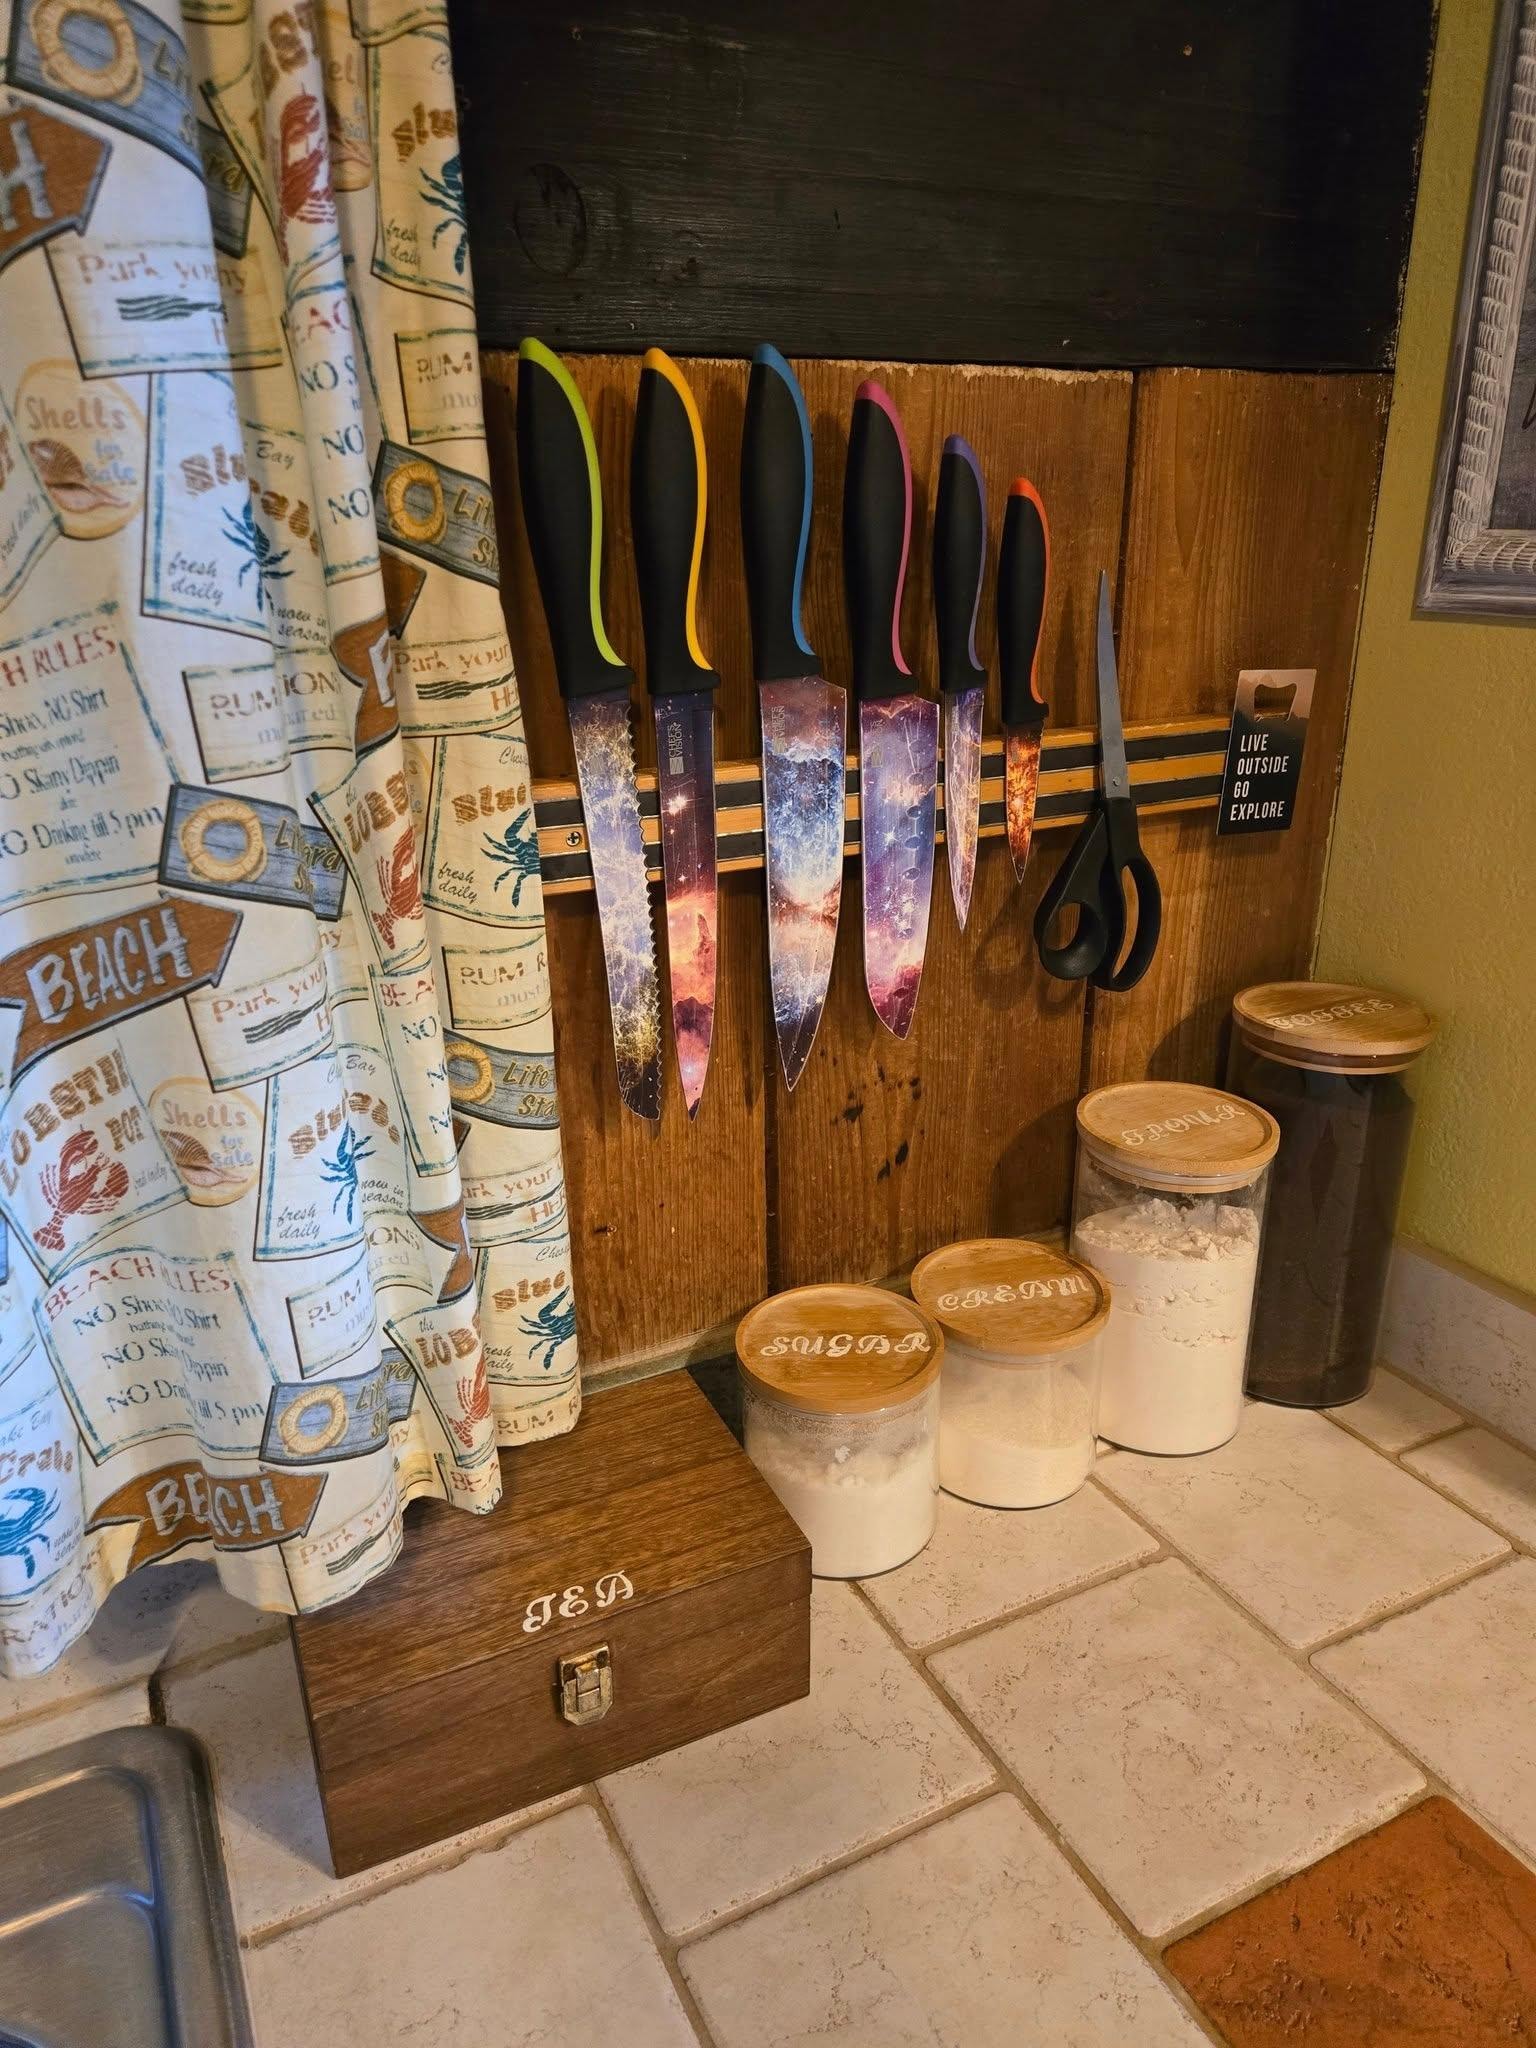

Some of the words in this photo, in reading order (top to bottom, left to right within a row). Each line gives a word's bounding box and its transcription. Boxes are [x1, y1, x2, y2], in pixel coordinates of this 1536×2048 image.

[25, 396, 126, 431] Shells
[321, 423, 365, 461] NO
[327, 487, 370, 526] NO
[168, 550, 219, 580] fresh
[170, 577, 224, 609] daily
[1240, 733, 1269, 753] LIVE
[1236, 755, 1289, 776] OUTSIDE
[1233, 780, 1250, 799] GO
[1230, 800, 1285, 821] EXPLORE
[438, 862, 475, 884] fresh
[438, 880, 478, 905] daily
[25, 907, 193, 1024] BEACH
[460, 961, 525, 987] RUM
[1265, 998, 1395, 1029] COFFEE
[401, 1015, 439, 1045] NO
[345, 1054, 377, 1077] Bay
[502, 1060, 550, 1089] Life
[161, 1098, 248, 1129] Shells
[361, 1178, 388, 1191] now
[277, 1202, 317, 1228] fresh
[279, 1219, 321, 1241] daily
[936, 1276, 1089, 1312] CREAM
[72, 1302, 117, 1336] NO
[102, 1341, 146, 1370] NO
[760, 1332, 931, 1358] SUGAR
[106, 1383, 150, 1414] NO
[522, 1569, 634, 1633] TEA
